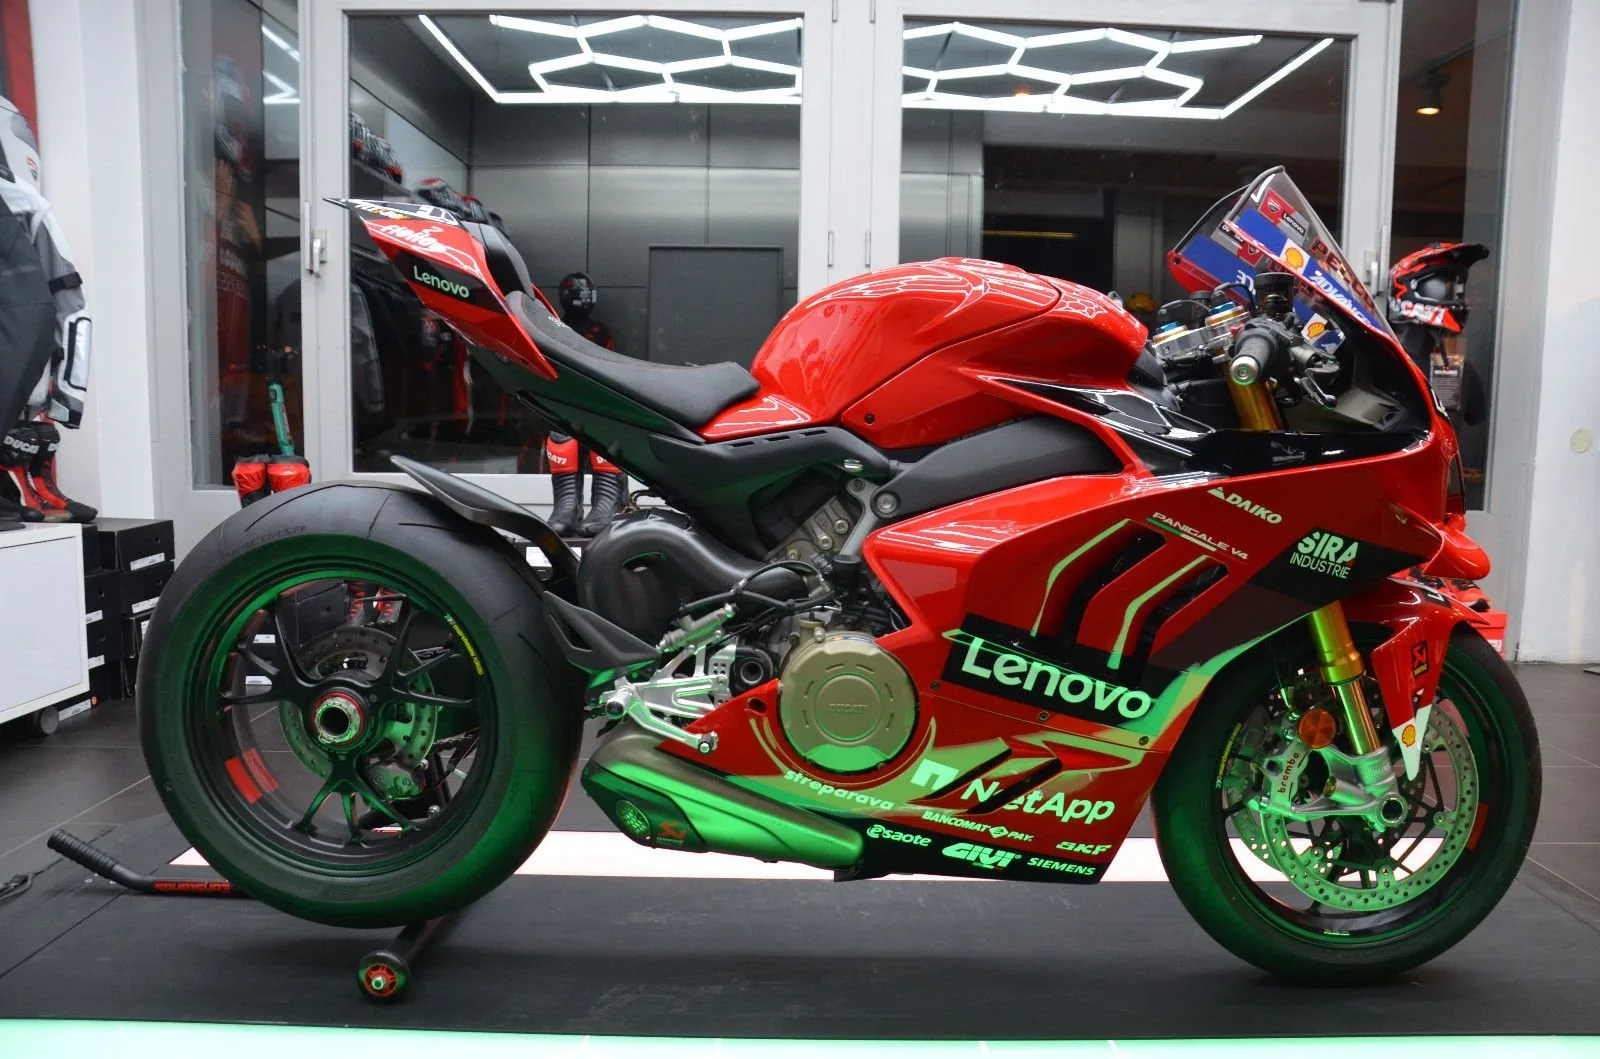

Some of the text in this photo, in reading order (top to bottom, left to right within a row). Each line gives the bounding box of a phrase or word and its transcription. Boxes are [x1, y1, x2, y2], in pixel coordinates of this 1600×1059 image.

[1283, 212, 1304, 234] Lenovo
[413, 265, 470, 298] Lenovo
[1309, 270, 1372, 325] ADVANC
[1225, 493, 1283, 524] DAIKO
[1152, 511, 1249, 560] PANIGALE V4
[1297, 531, 1359, 564] SIRA
[1289, 551, 1352, 579] INDUSTRIE
[961, 636, 1152, 720] Lenovo
[1277, 751, 1301, 794] brembo
[783, 769, 896, 810] streparava
[866, 823, 933, 847] esaote
[922, 810, 991, 833] BANCOMAT
[1056, 841, 1113, 856] SKF
[1027, 857, 1097, 876] SIEMENS
